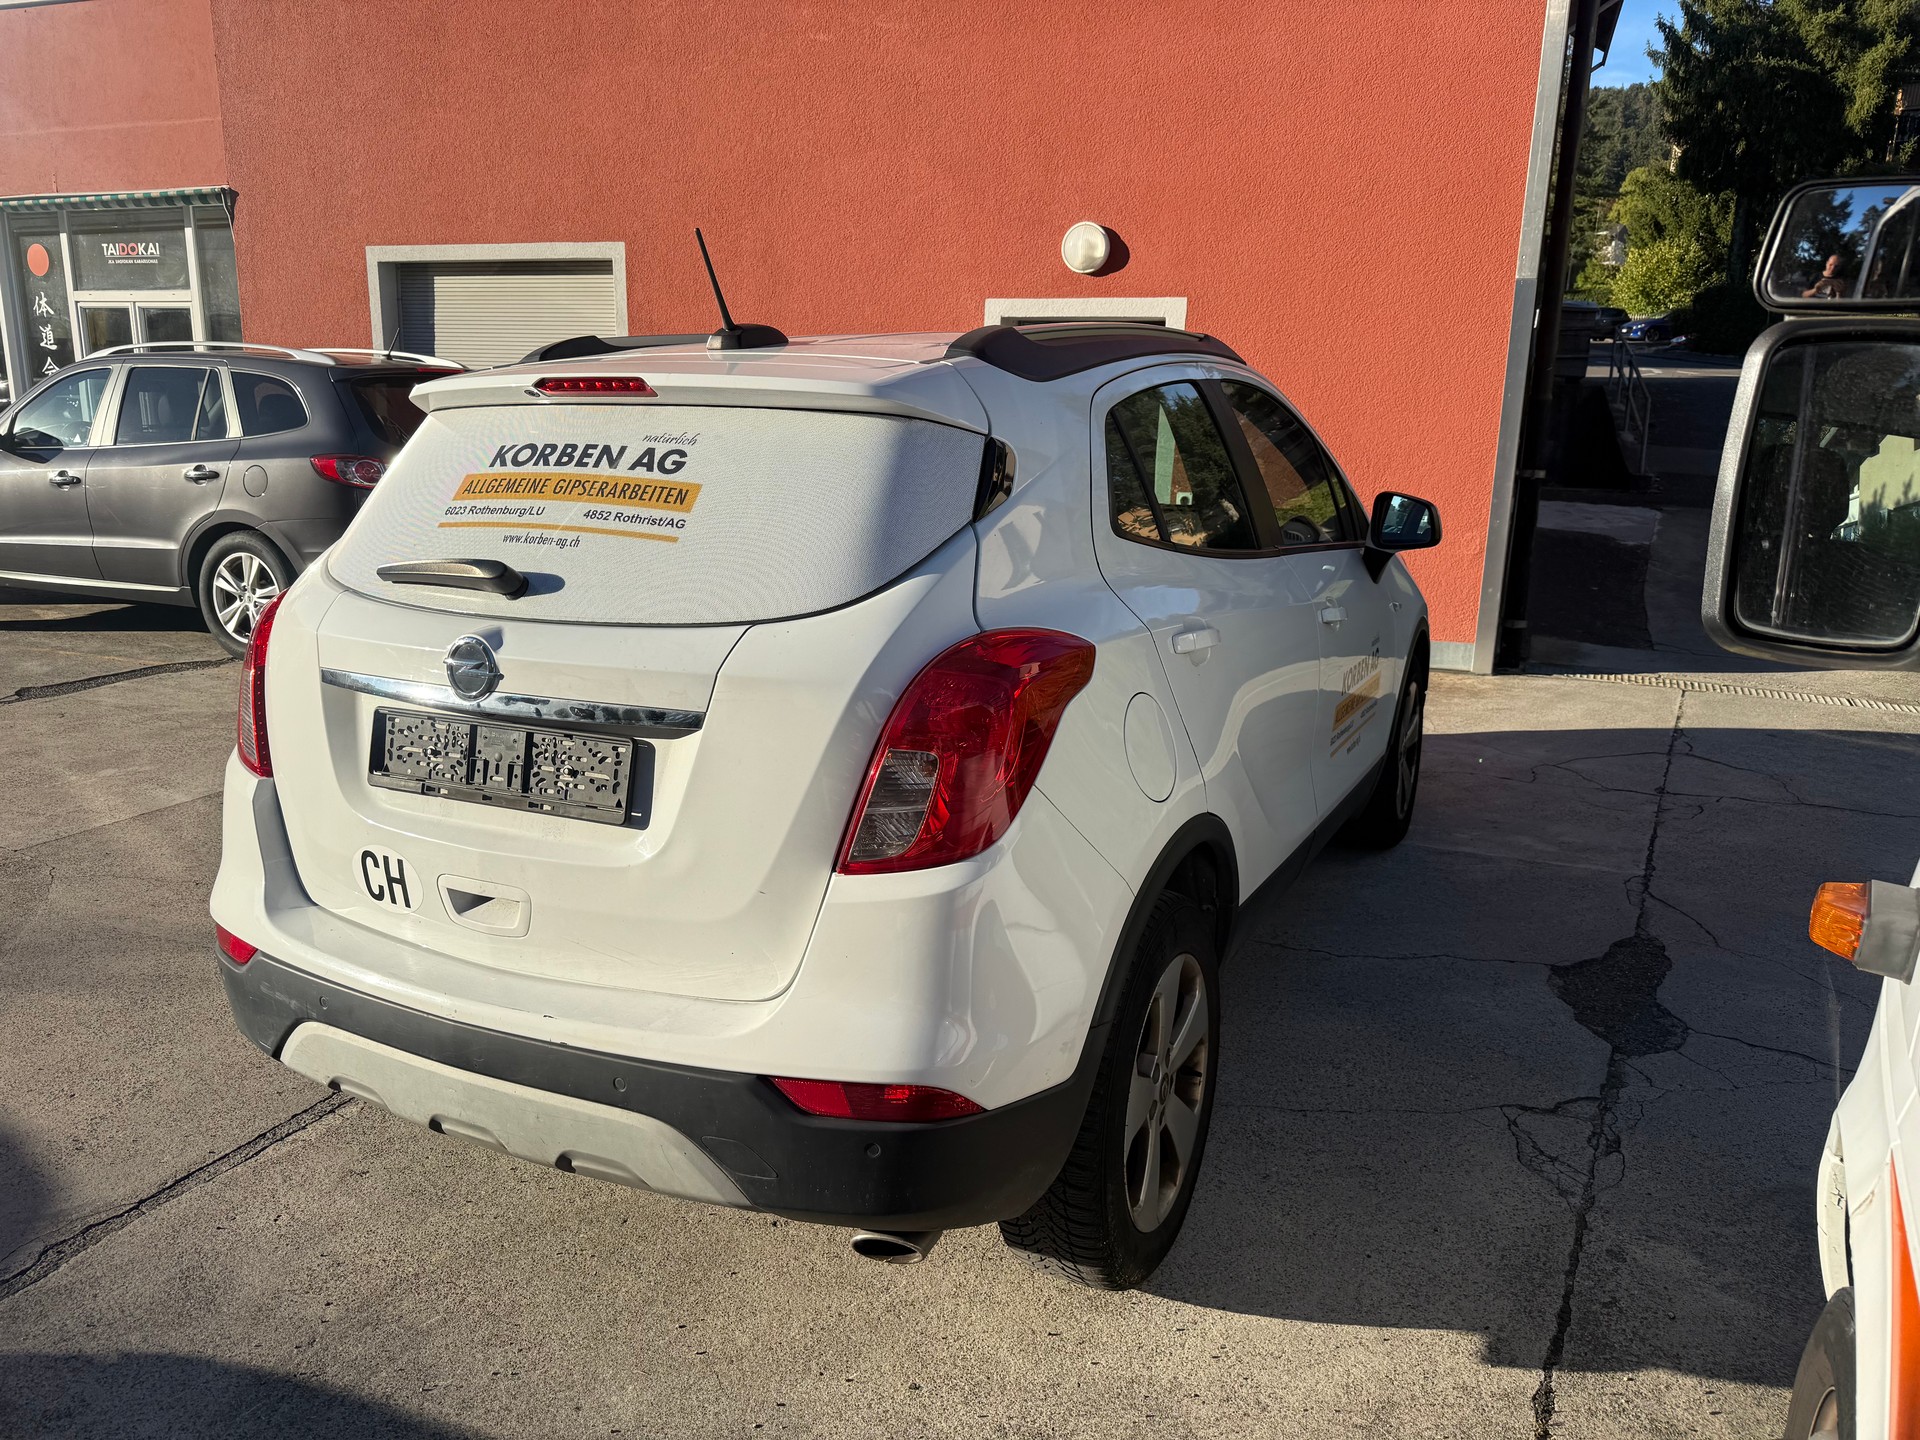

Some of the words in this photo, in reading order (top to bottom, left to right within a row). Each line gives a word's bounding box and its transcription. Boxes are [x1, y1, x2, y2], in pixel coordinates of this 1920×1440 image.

[101, 242, 160, 256] TAIDOKAI
[642, 431, 700, 446] natürlich
[489, 442, 628, 469] KORBEN
[627, 447, 688, 475] AG
[462, 478, 551, 495] ALLGEMEINE
[552, 479, 690, 506] GIPSERARBEITEN
[444, 506, 467, 516] 6023
[467, 505, 546, 518] Rothenburg/LU
[583, 509, 612, 521] 4852
[613, 512, 687, 529] Rothrist/AG
[502, 531, 580, 550] www.korben-ag.ch
[1341, 655, 1370, 696] KORBEN
[361, 849, 412, 909] CH
